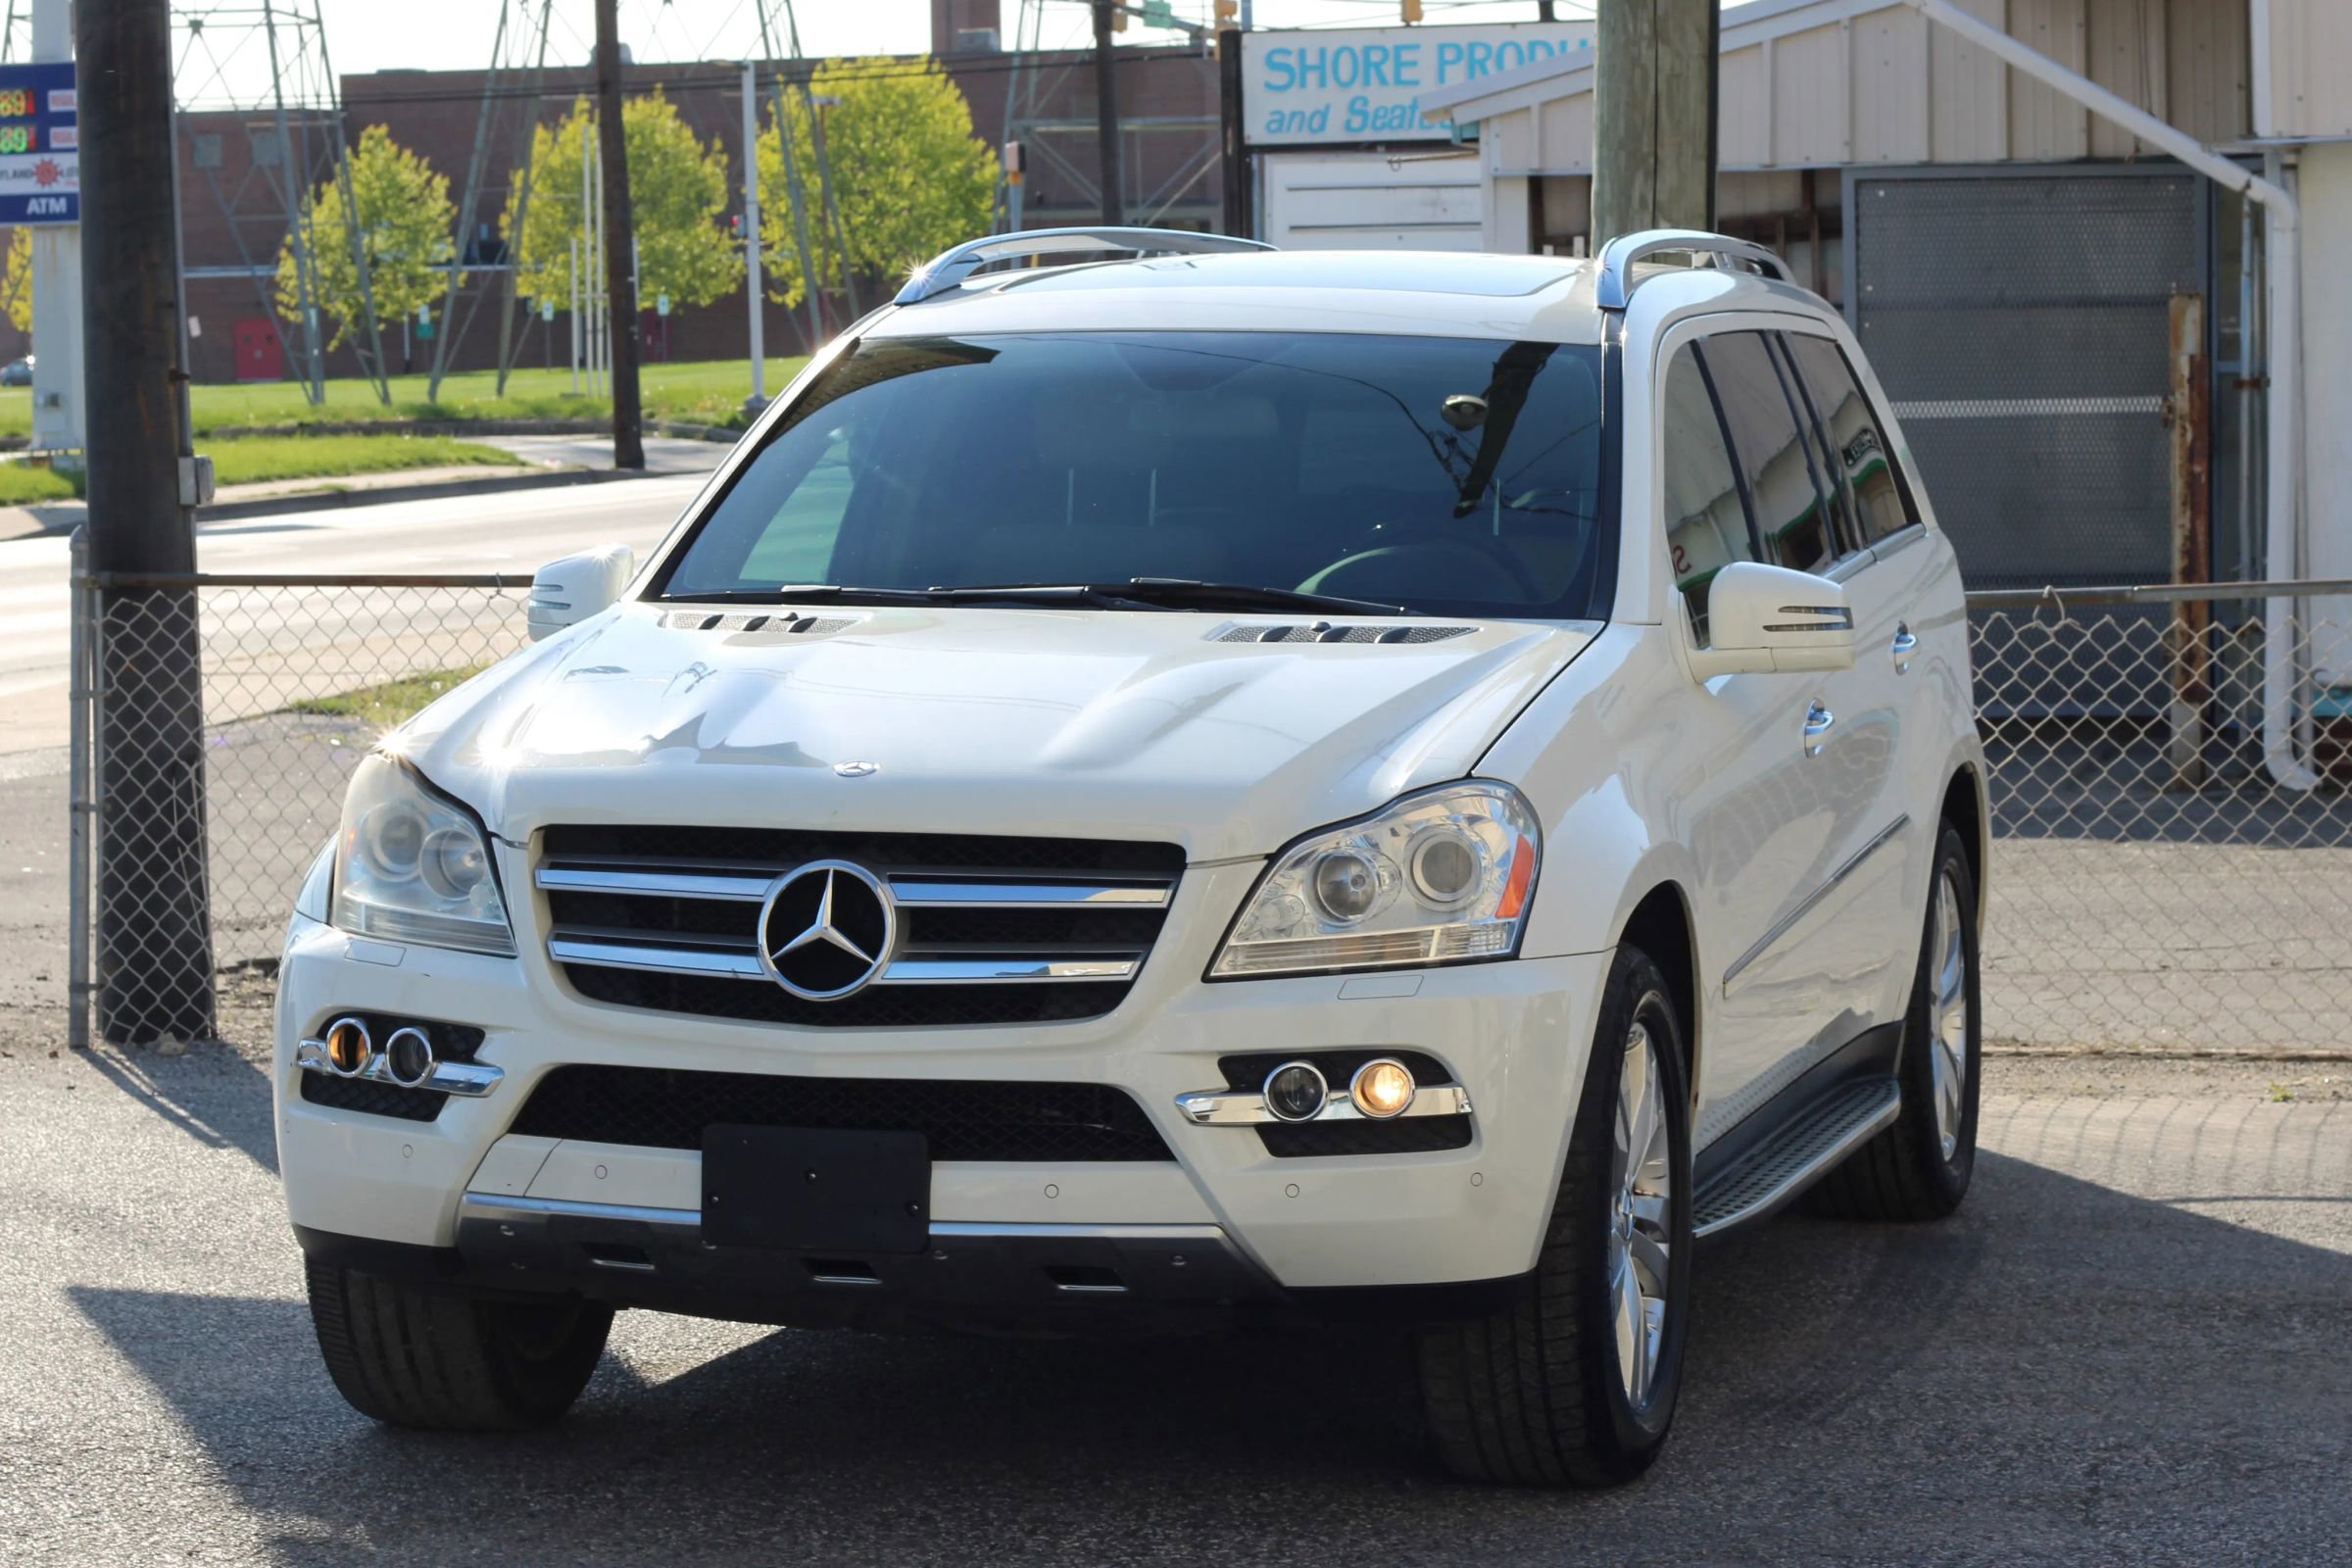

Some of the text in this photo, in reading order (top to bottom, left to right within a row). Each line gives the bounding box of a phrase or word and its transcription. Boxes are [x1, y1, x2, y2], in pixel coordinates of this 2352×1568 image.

[1264, 43, 1420, 91] SHORE
[1265, 95, 1452, 134] and Seaf
[26, 197, 68, 216] ATM
